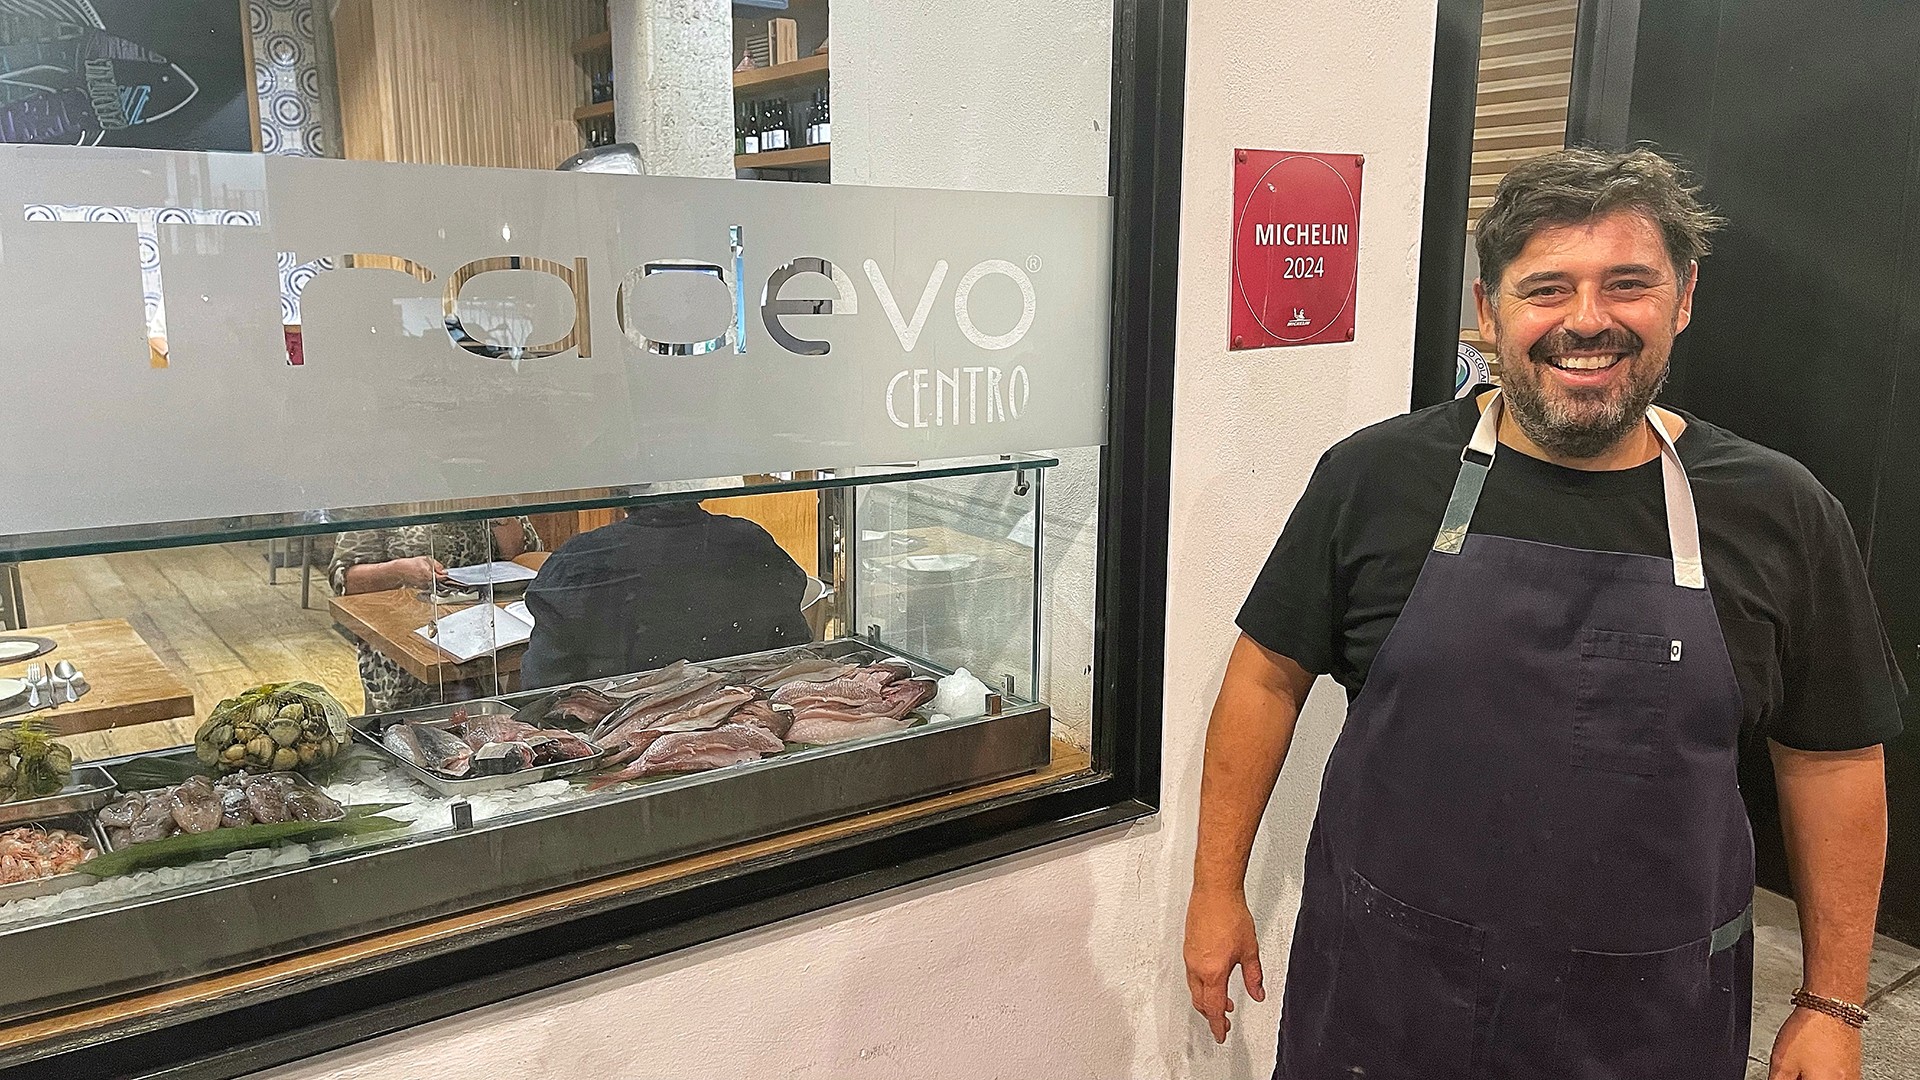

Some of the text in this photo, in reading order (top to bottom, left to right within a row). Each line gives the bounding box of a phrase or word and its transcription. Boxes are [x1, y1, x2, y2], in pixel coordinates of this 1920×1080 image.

[1255, 223, 1349, 246] MICHELIN
[1283, 256, 1325, 279] 2024
[886, 365, 1030, 429] CENTRO
